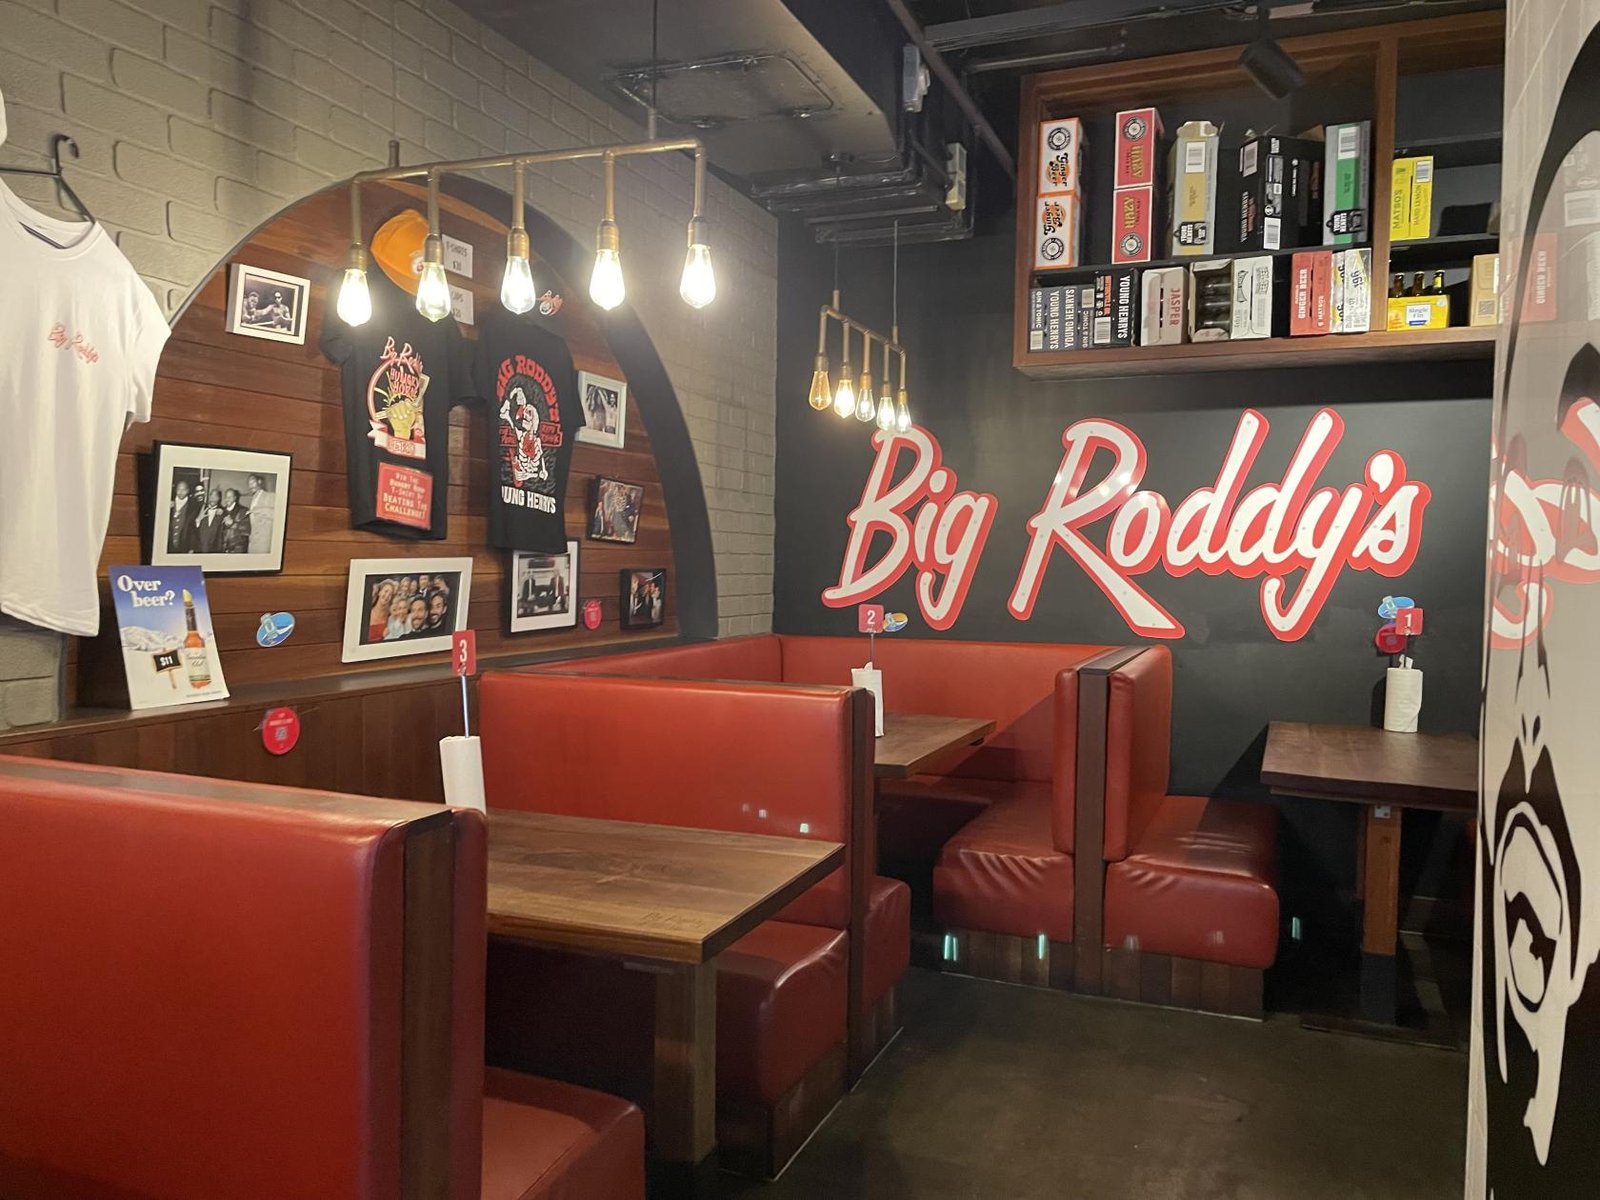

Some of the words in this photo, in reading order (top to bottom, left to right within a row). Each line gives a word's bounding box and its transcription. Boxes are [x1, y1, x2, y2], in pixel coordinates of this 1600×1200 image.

[1049, 161, 1058, 187] Beer
[1056, 152, 1069, 187] Ginger
[1043, 201, 1056, 236] Ginger
[1053, 201, 1063, 228] Beer
[1119, 275, 1130, 304] YOUNG
[1299, 268, 1308, 289] BEER
[1050, 290, 1059, 318] YOUNG
[1065, 289, 1074, 320] HENRYS
[1169, 287, 1181, 326] JASPER
[1298, 291, 1306, 319] GINGER
[1050, 319, 1059, 350] HENRYS
[1065, 321, 1074, 348] YOUNG
[1118, 305, 1129, 339] HENRYS
[380, 336, 397, 366] Big
[822, 424, 998, 630] Big
[1007, 408, 1432, 642] Roddy's
[117, 574, 161, 592] Over
[132, 590, 175, 608] beer?
[867, 609, 876, 625] 2
[1404, 613, 1412, 627] 1
[459, 639, 468, 663] 3
